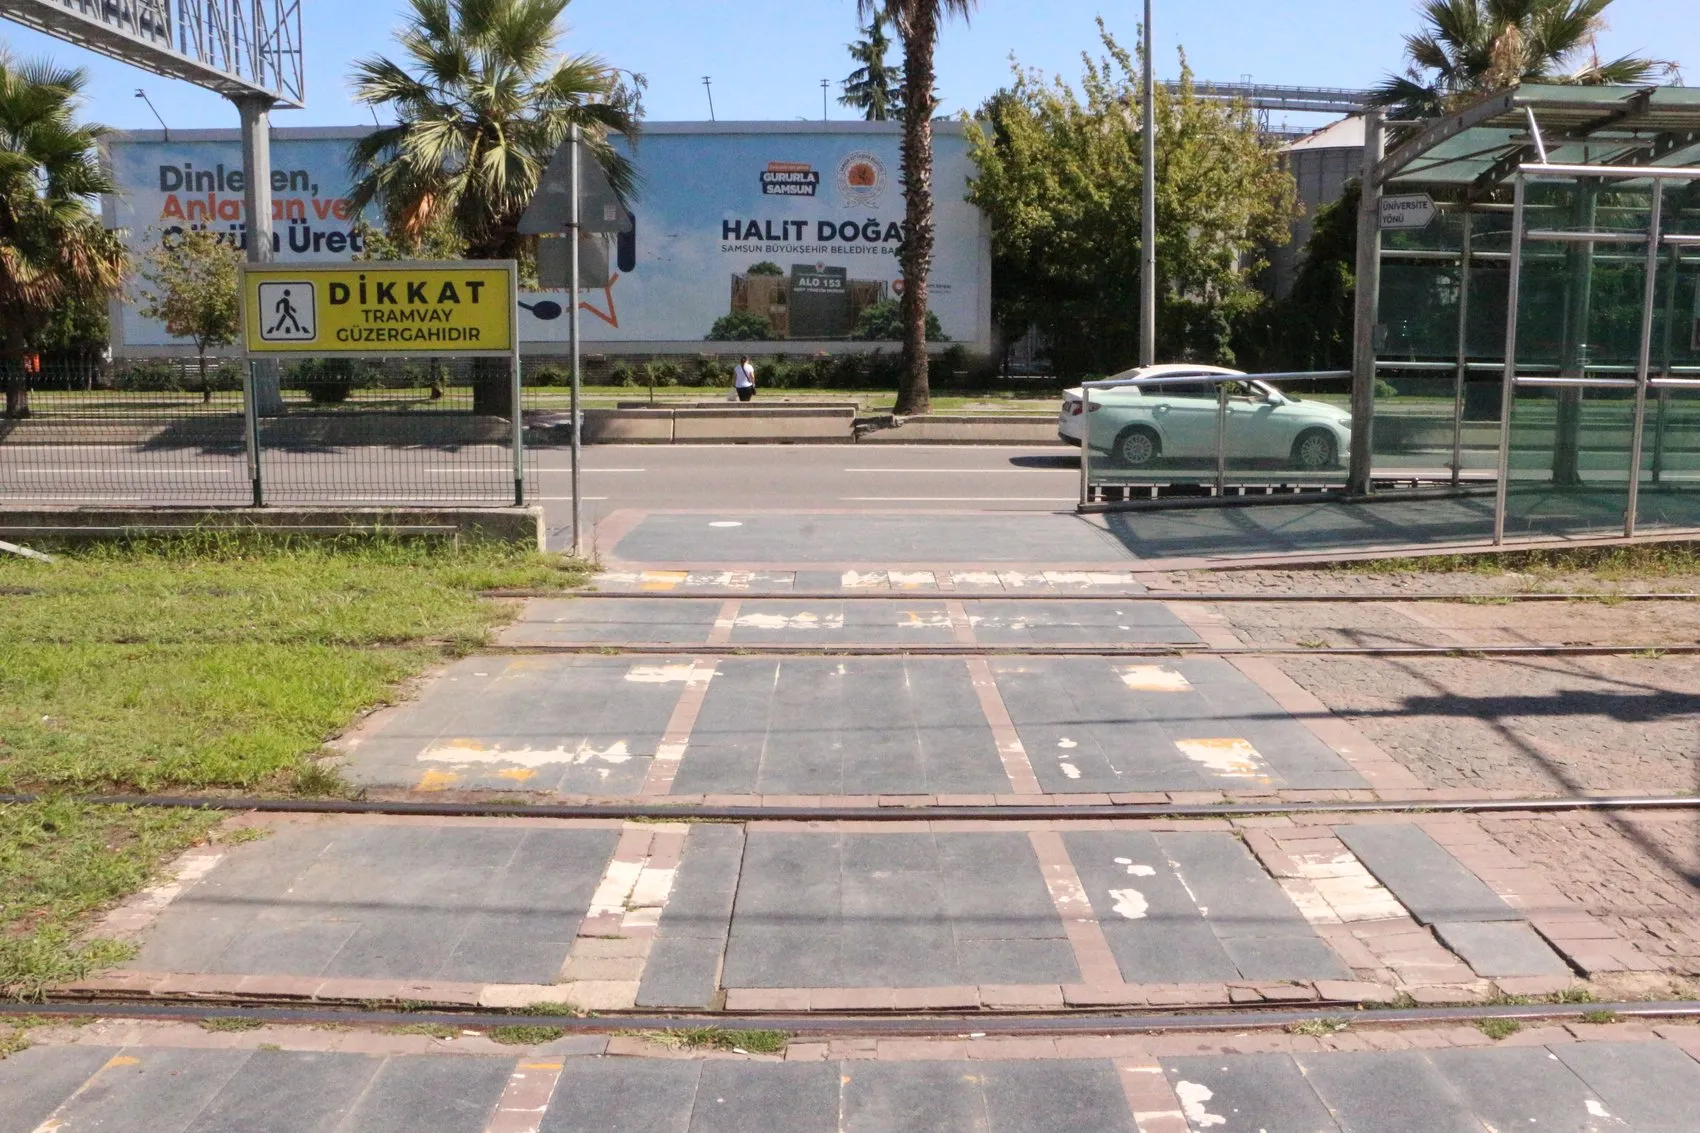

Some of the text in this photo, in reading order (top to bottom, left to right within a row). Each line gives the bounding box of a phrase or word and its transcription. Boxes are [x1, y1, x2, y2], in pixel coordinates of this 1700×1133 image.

[160, 163, 319, 197] Dinleen,
[763, 173, 815, 182] GURURLA
[766, 185, 812, 194] SAMSUN
[160, 193, 352, 221] Anlaan ve
[289, 218, 379, 253] Üret
[817, 217, 904, 242] DOĞA
[721, 244, 762, 253] SAMSUN
[766, 242, 827, 255] BÜYÜKŞEHİR
[831, 244, 878, 255] BELEDİYE
[329, 274, 486, 305] DİKKAT
[798, 277, 841, 288] ALO 153
[361, 309, 453, 323] TRAMVAY
[336, 325, 481, 342] GÜZERGAHIDIR
